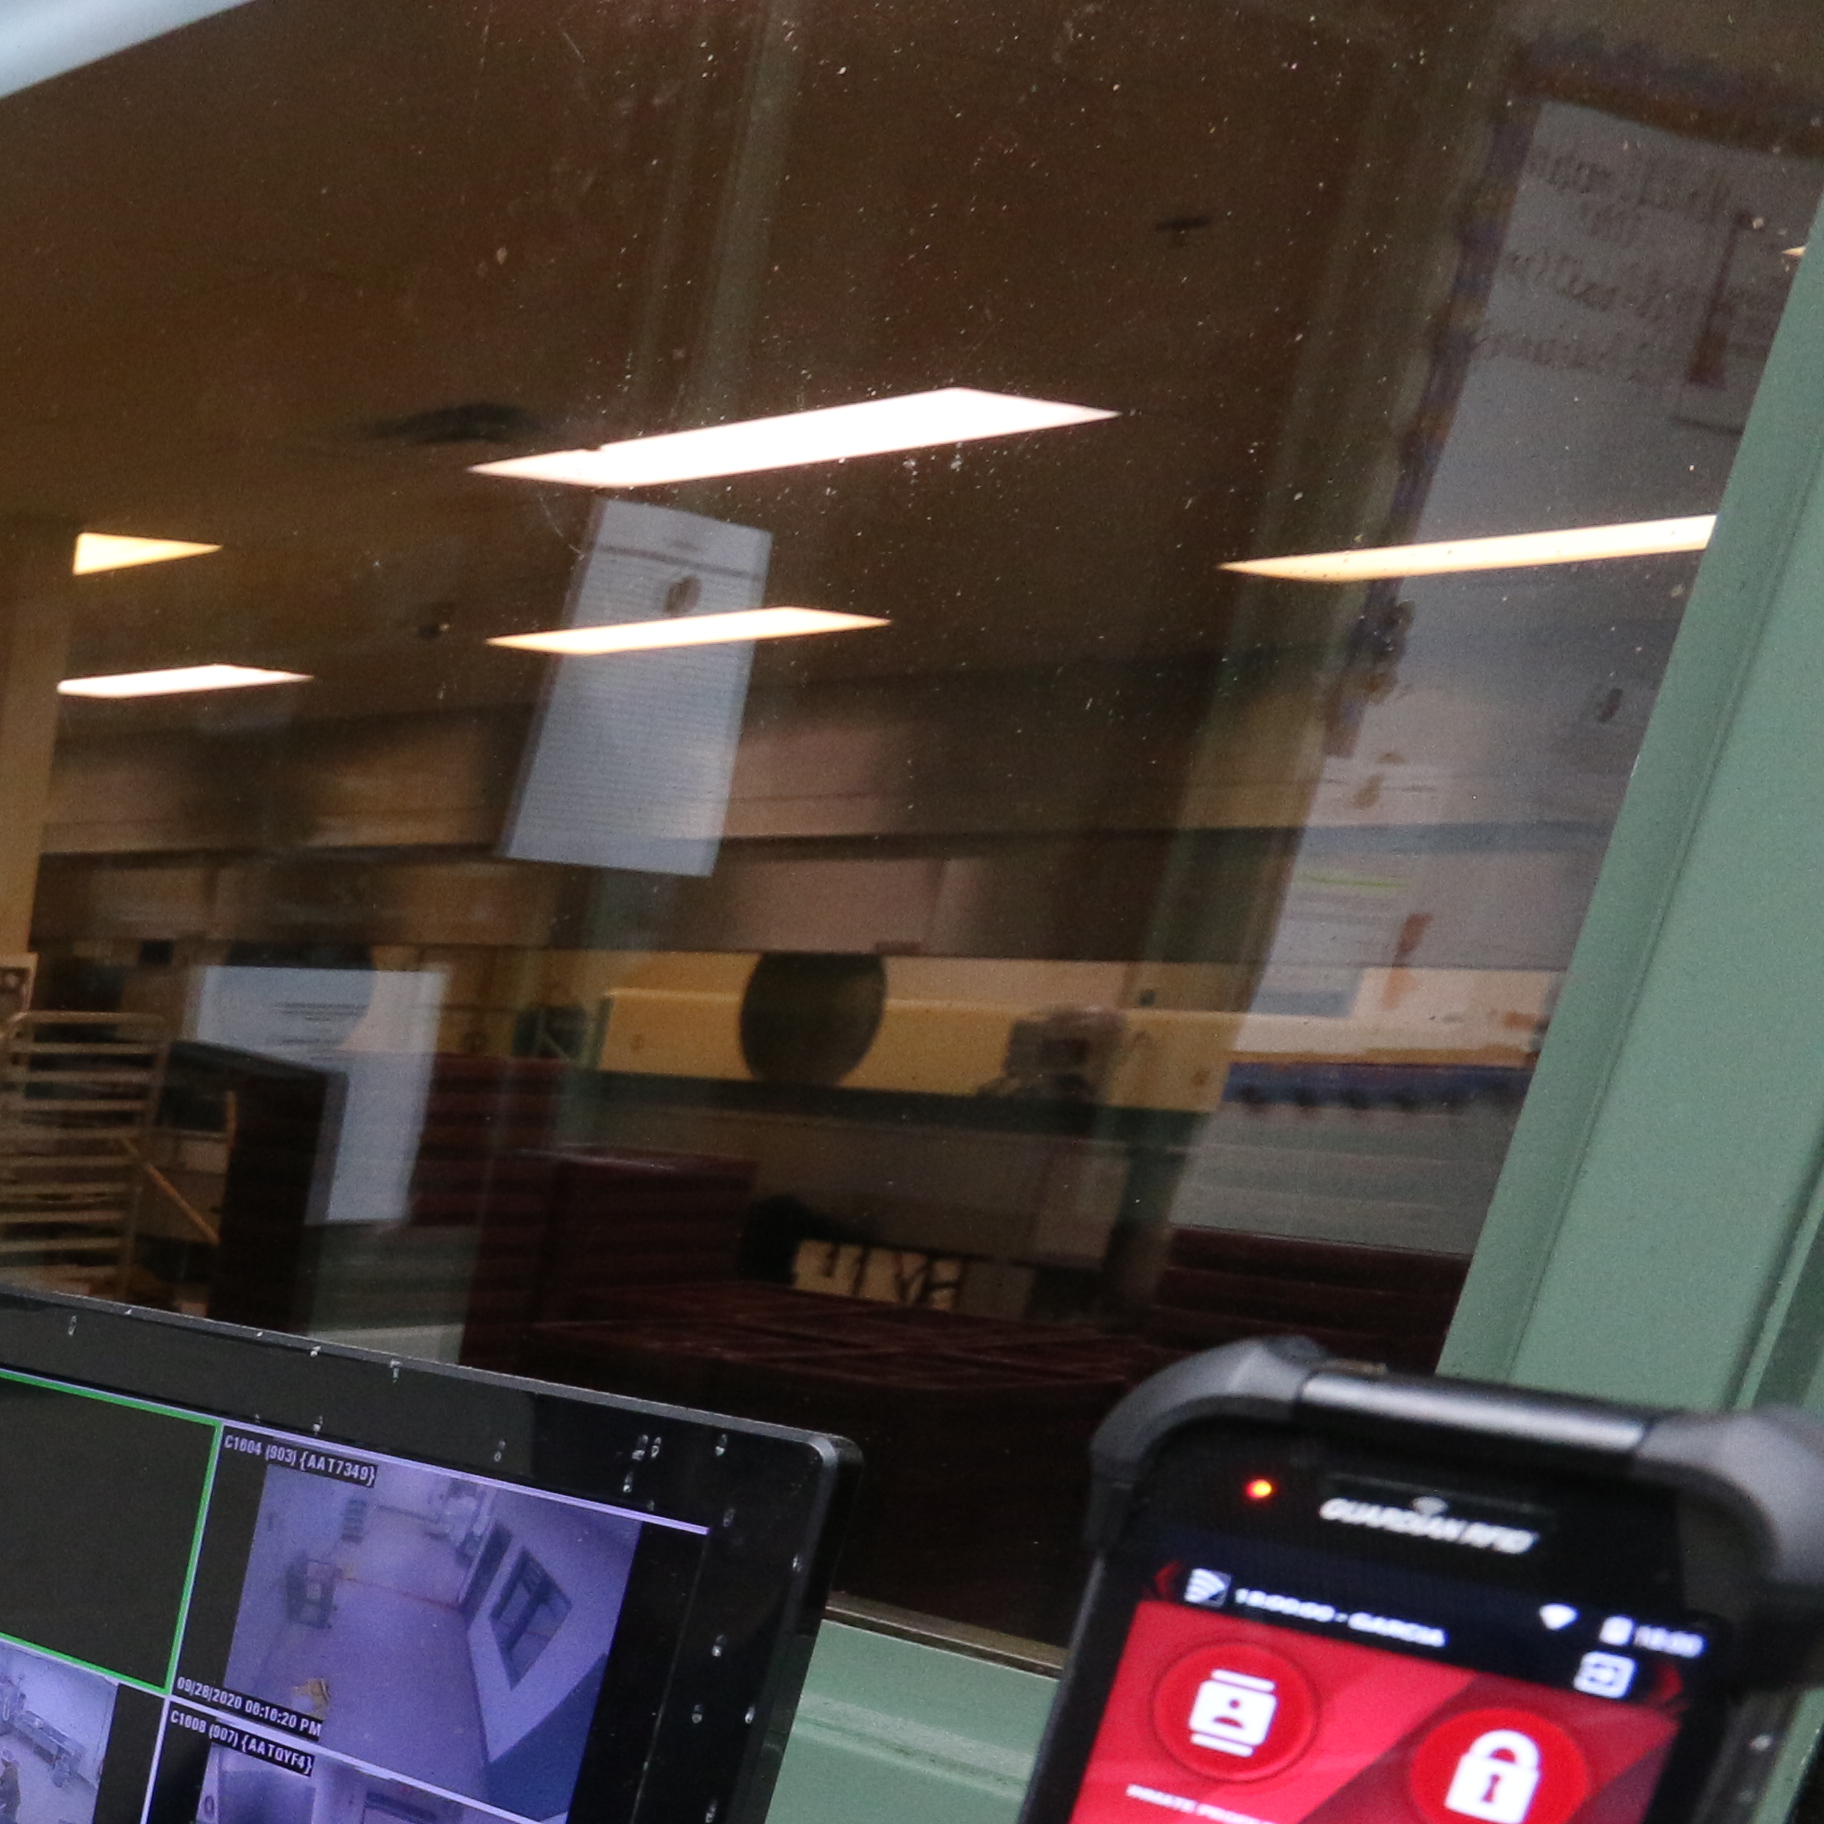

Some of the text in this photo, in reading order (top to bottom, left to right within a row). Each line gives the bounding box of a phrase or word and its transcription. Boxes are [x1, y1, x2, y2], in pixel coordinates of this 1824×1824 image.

[265, 1445, 297, 1467] (903)
[299, 1451, 376, 1487] {AAT7349}
[299, 1718, 322, 1737] PM
